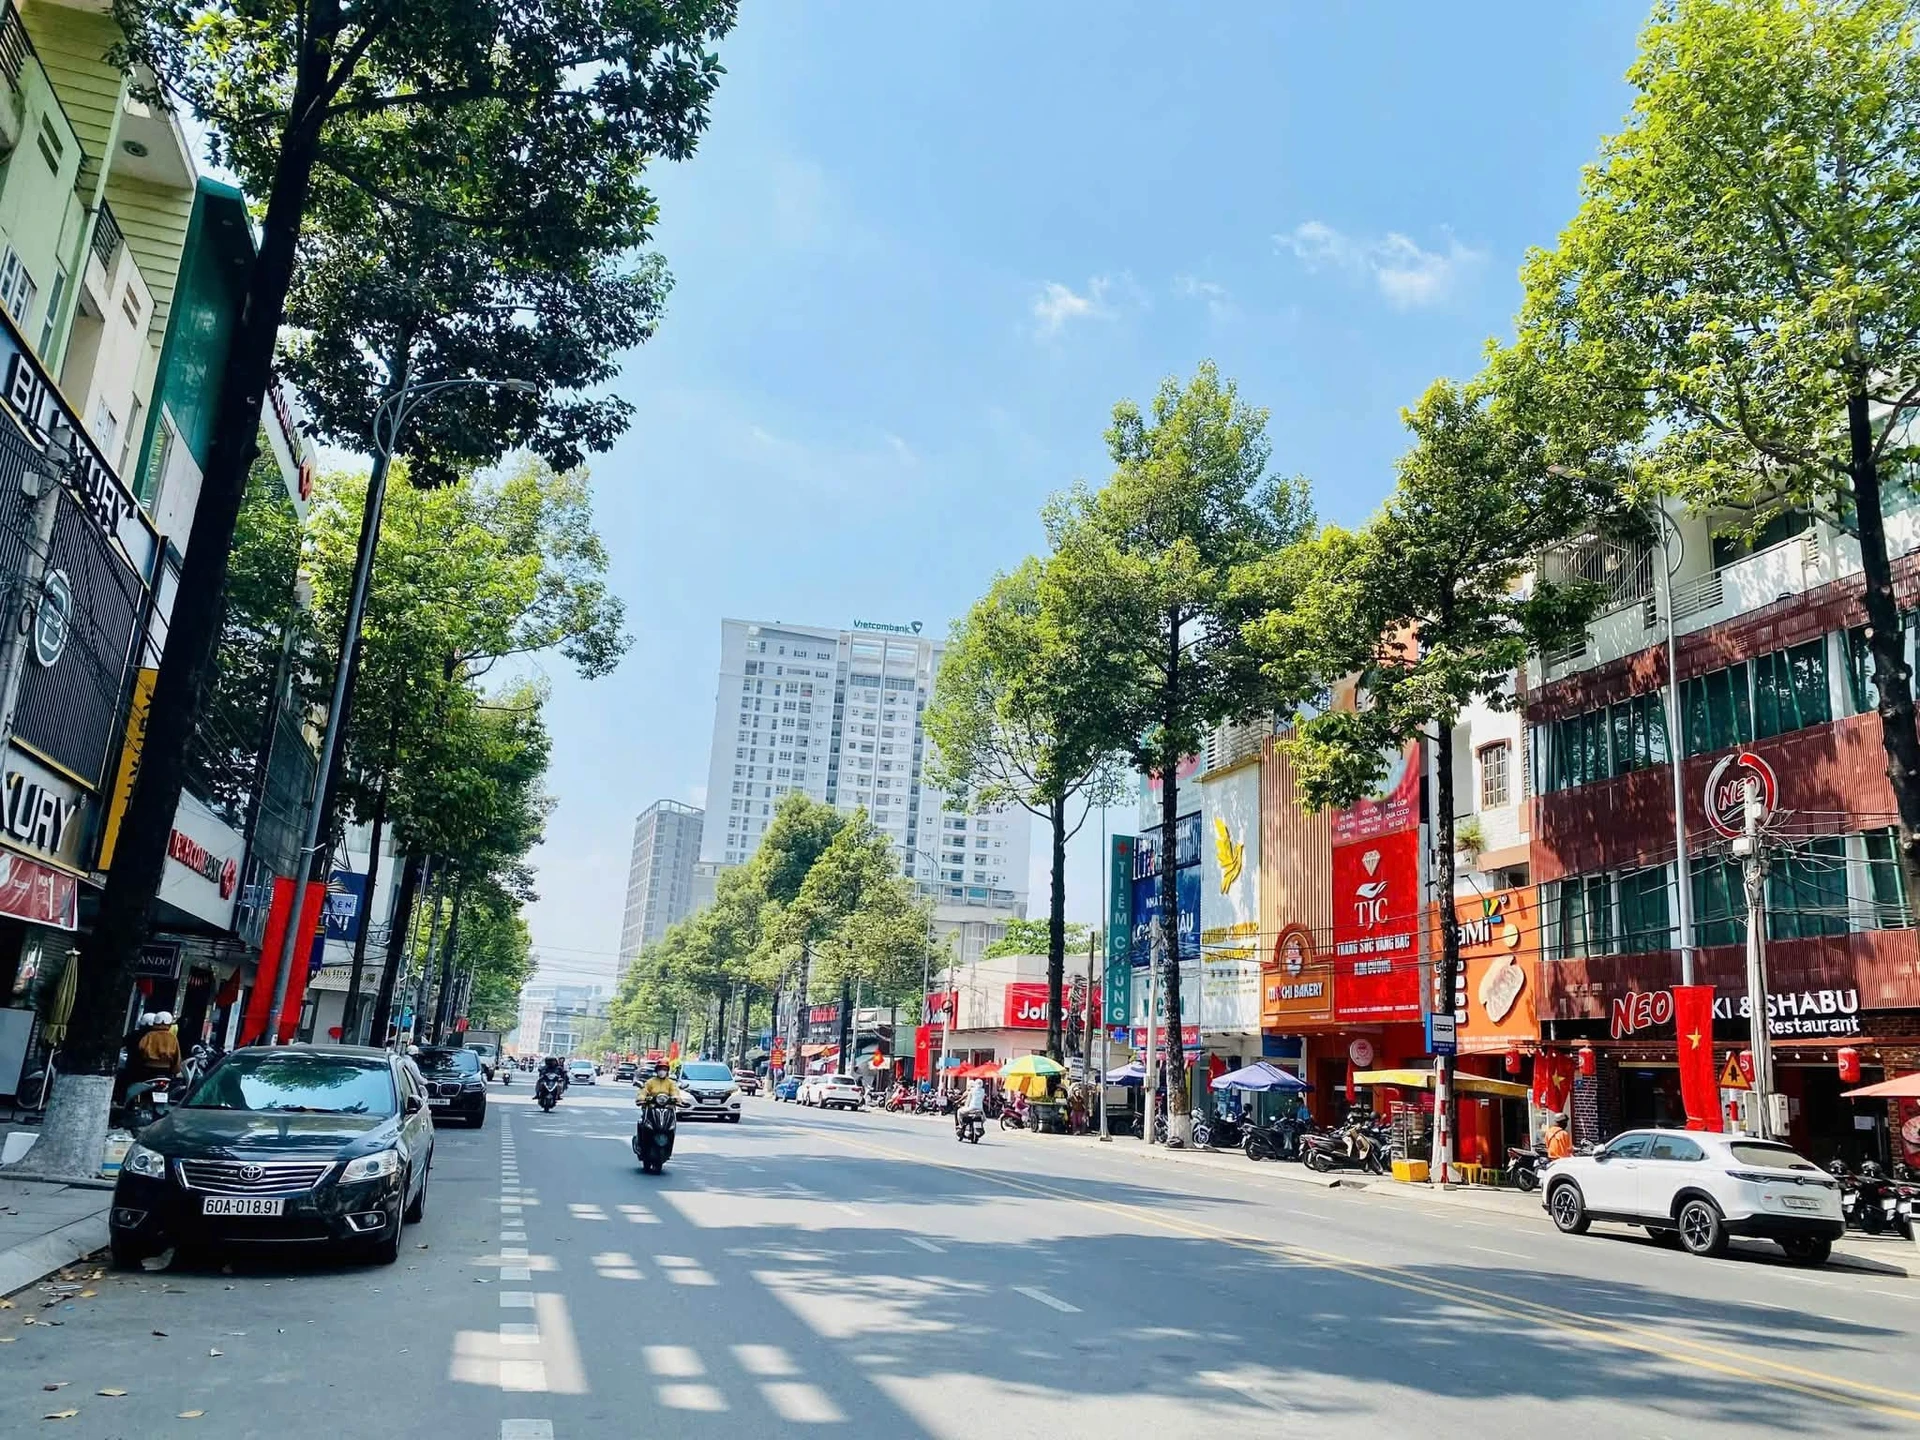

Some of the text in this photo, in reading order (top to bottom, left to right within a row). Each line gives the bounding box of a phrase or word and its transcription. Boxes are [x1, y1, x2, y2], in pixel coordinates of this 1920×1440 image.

[853, 619, 910, 634] Vietcombank
[1354, 897, 1389, 931] TJC
[1457, 920, 1490, 946] aMi
[1294, 982, 1323, 998] BAKERY
[1611, 992, 1674, 1039] NEO
[1712, 998, 1733, 1019] KI
[1766, 990, 1858, 1017] SHABU
[1767, 1016, 1861, 1035] Restaurant
[206, 1199, 279, 1214] 60A-018.91
